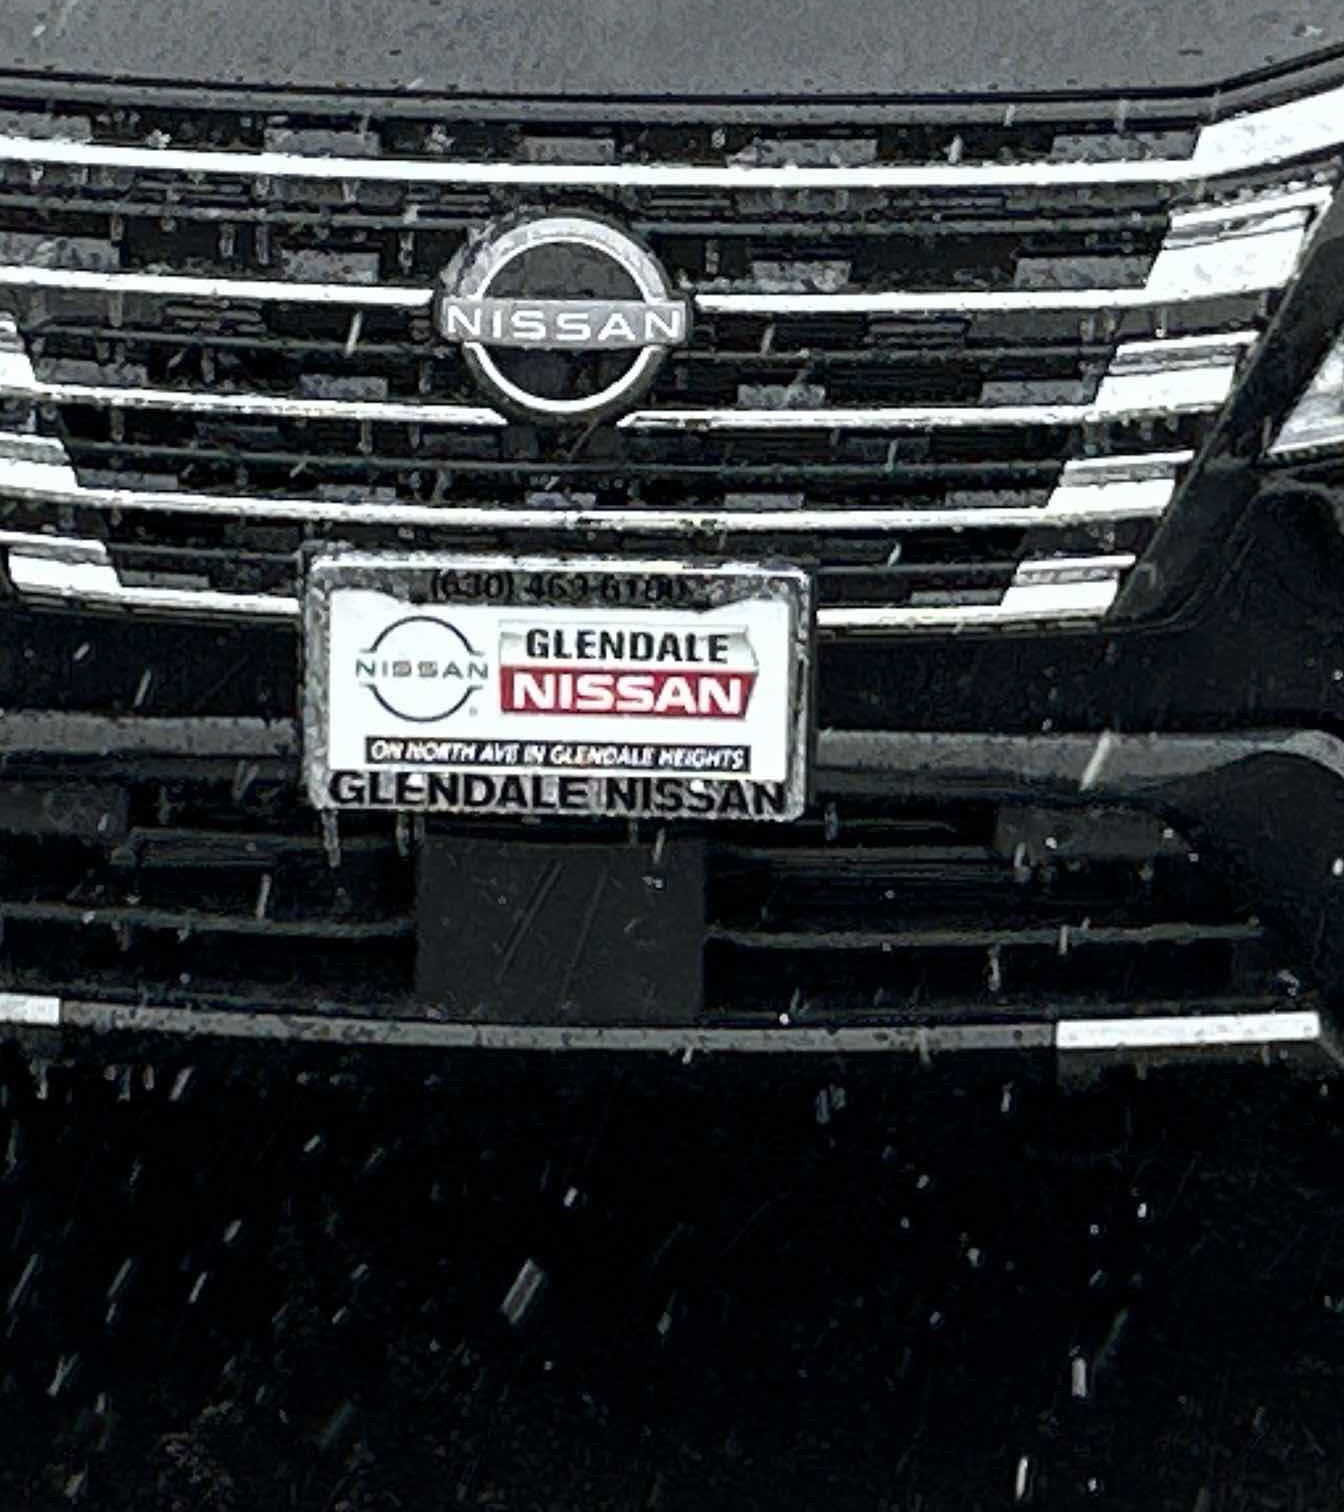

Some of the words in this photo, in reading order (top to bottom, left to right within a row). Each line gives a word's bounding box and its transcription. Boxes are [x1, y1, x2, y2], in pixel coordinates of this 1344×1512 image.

[447, 305, 681, 341] NISSAN
[525, 628, 729, 665] GLENDALE
[356, 659, 489, 680] NISSAN
[511, 671, 742, 714] NISSAN
[371, 740, 405, 761] ON
[405, 741, 476, 763] NORTH
[550, 744, 655, 769] GLENDALE
[658, 746, 745, 771] HEIGHTS
[328, 770, 587, 809] GLENDALE
[604, 777, 786, 816] NISSAN
